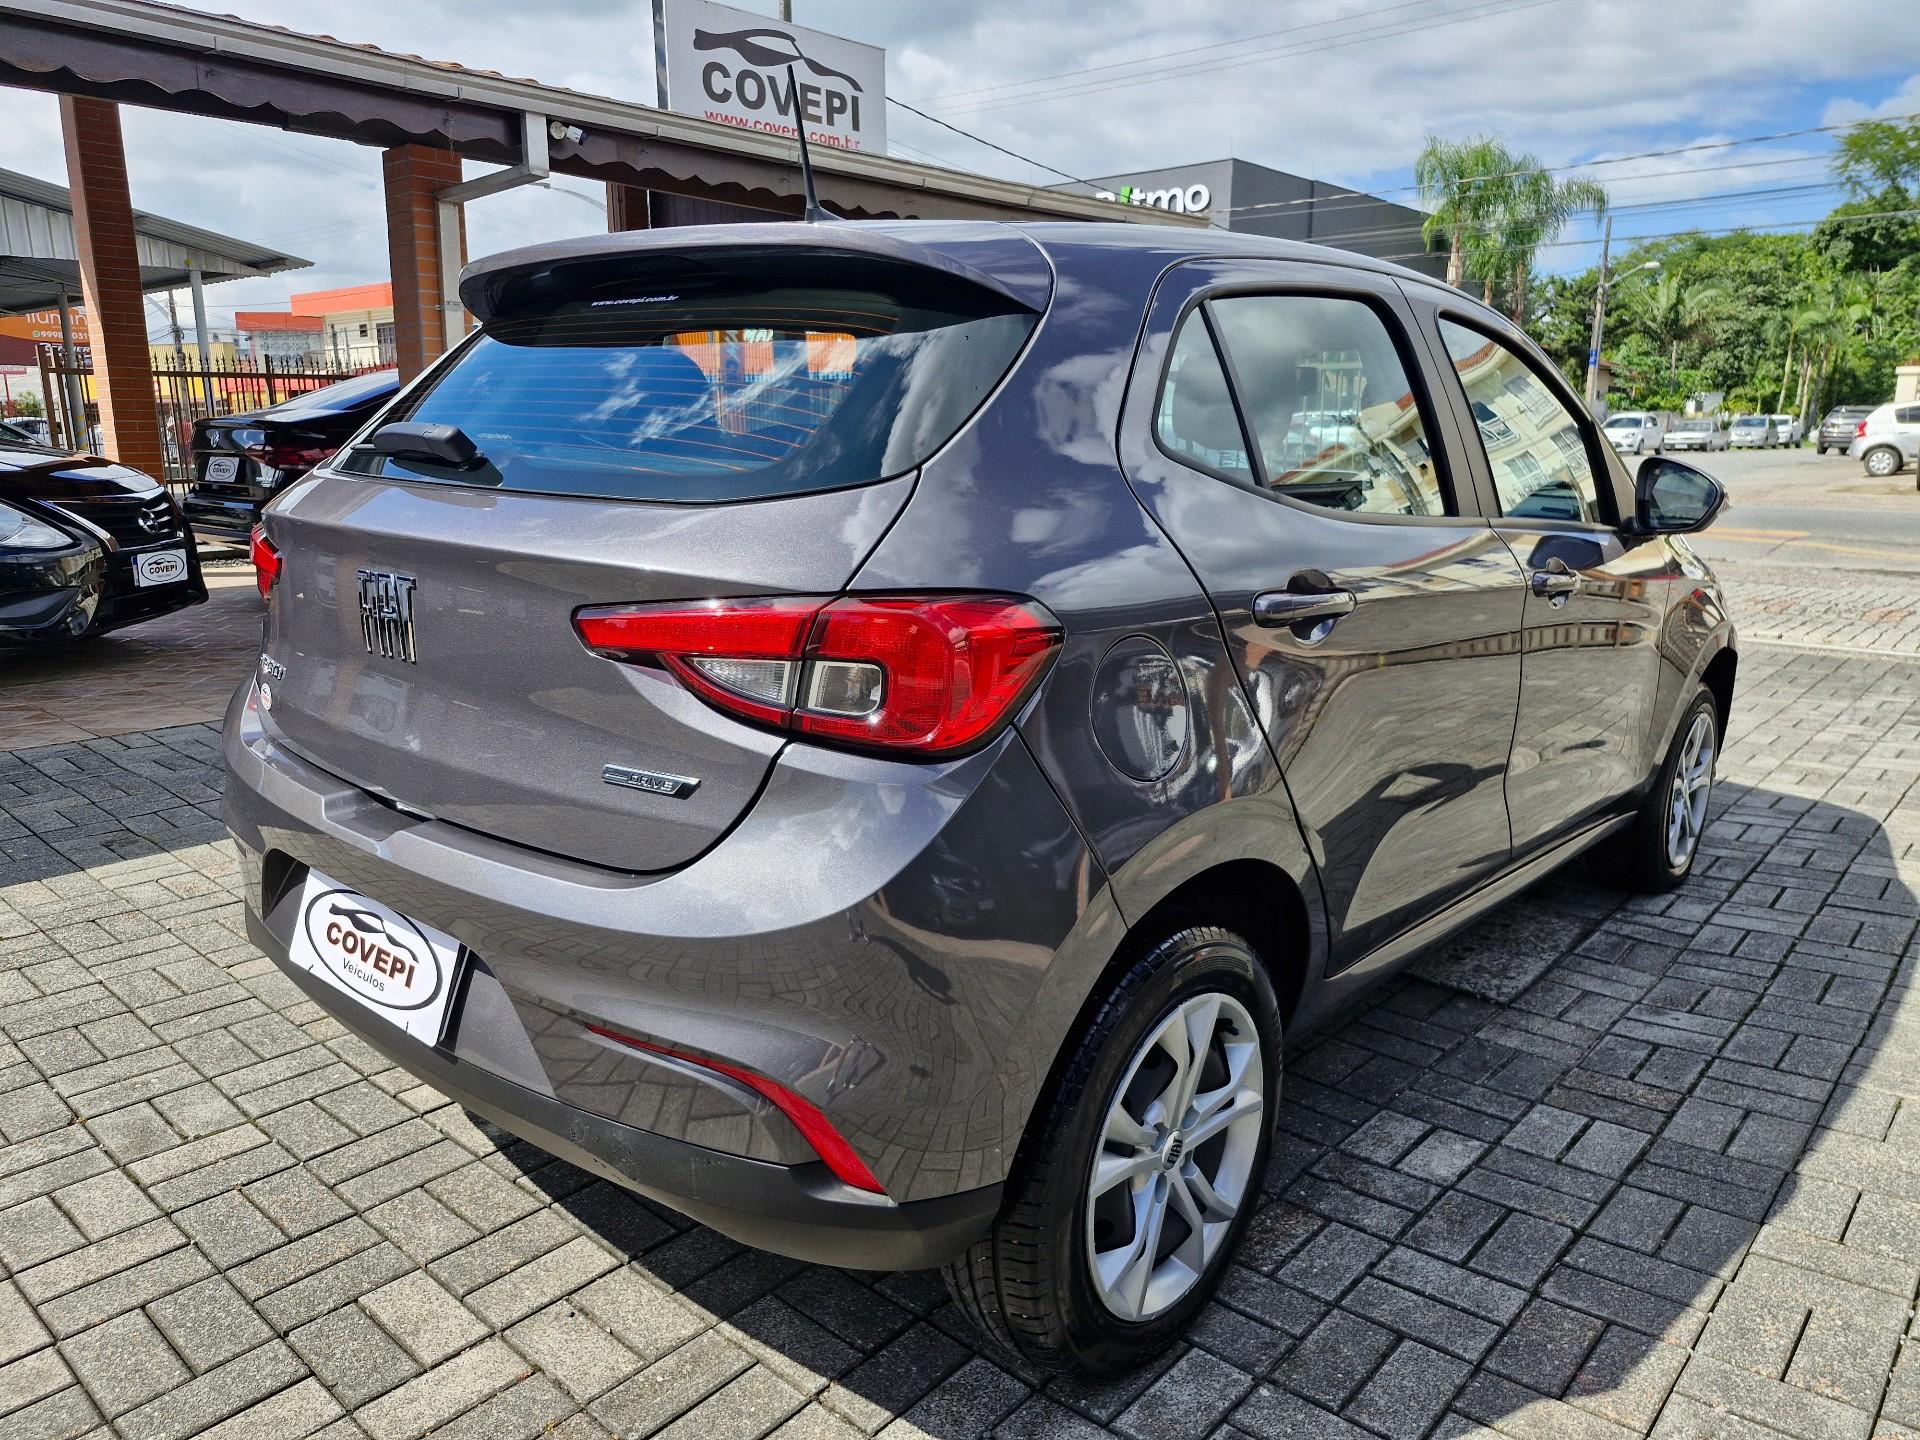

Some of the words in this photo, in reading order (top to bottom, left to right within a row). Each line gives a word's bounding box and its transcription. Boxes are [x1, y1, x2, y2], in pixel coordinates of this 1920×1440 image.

[702, 61, 861, 132] COVEPI
[704, 110, 861, 150] www.cove.com.br
[149, 564, 178, 575] COVEPI
[358, 569, 417, 665] FIAT
[628, 773, 674, 792] DRIVE
[326, 921, 416, 989] COVEPI
[1166, 1137, 1184, 1165] FIAT
